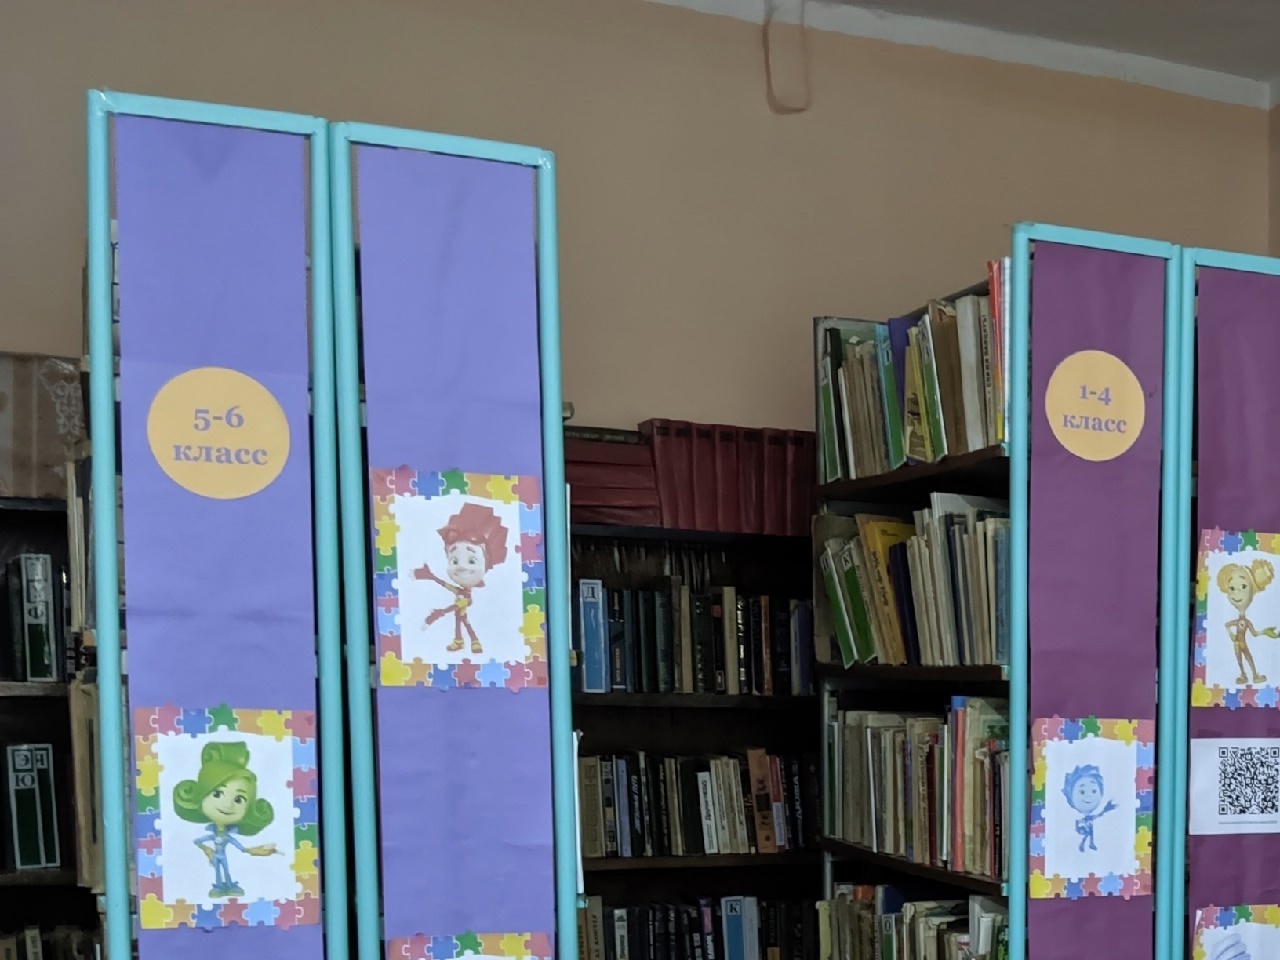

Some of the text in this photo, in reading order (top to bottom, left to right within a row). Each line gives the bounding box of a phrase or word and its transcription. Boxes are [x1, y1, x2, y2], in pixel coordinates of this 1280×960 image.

[1078, 384, 1112, 406] 1-4
[192, 405, 245, 431] 5-6
[1061, 411, 1128, 435] класс
[172, 440, 269, 467] класс
[14, 773, 36, 788] Ю
